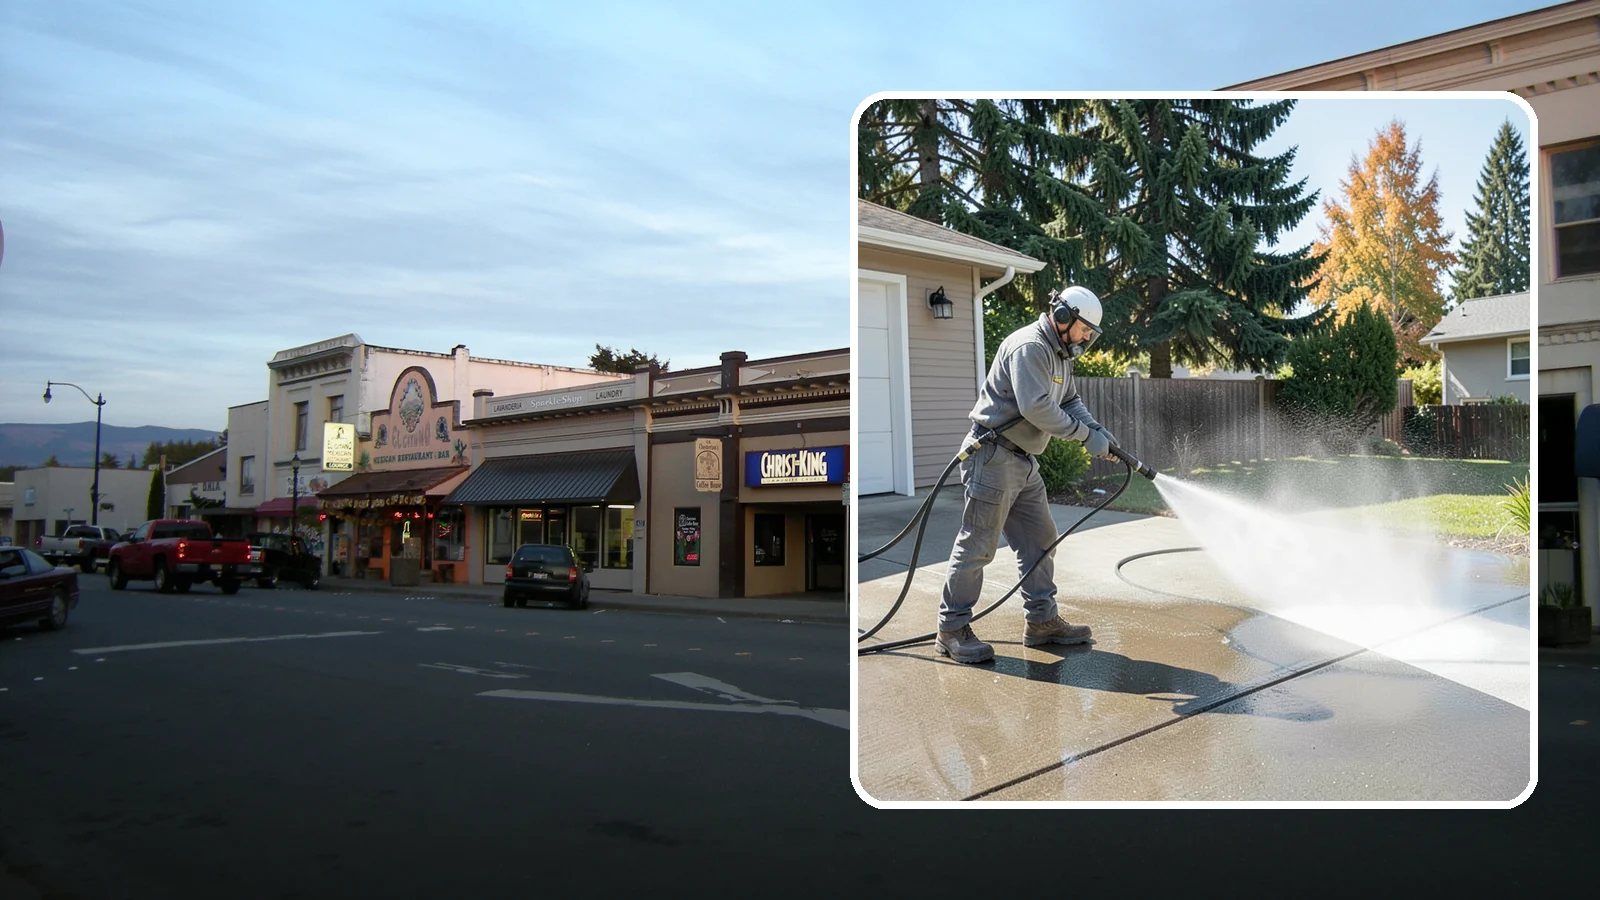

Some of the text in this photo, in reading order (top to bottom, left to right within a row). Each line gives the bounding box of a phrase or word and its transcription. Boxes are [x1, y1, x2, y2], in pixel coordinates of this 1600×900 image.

[595, 388, 624, 400] LAUNDRY
[493, 401, 523, 413] LAVANDERIA
[530, 394, 583, 410] Sparkle Shop
[373, 454, 396, 464] MEXICAN
[397, 451, 434, 462] RESTAURANT
[438, 450, 450, 459] BAR
[760, 449, 828, 478] CHRIST KING
